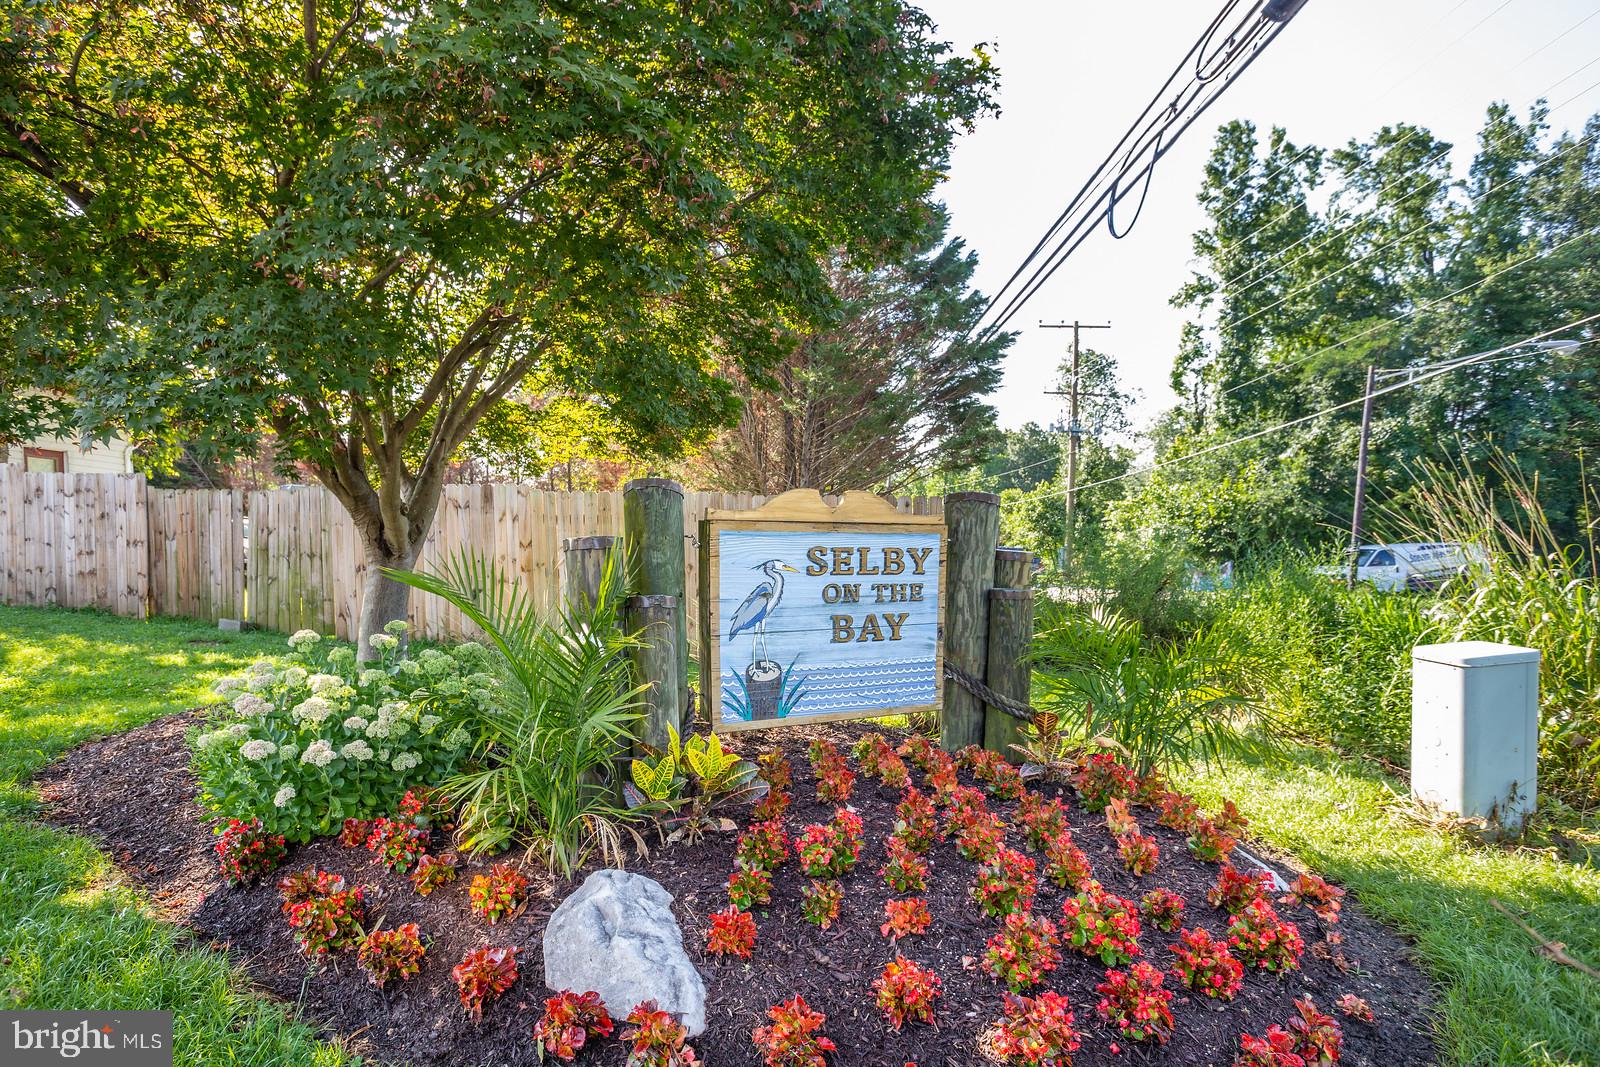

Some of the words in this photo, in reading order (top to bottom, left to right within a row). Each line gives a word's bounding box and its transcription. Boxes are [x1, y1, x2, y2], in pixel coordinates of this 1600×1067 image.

[806, 546, 933, 576] SELBY
[822, 583, 861, 604] ON
[871, 583, 924, 603] THE
[830, 613, 909, 643] BAY
